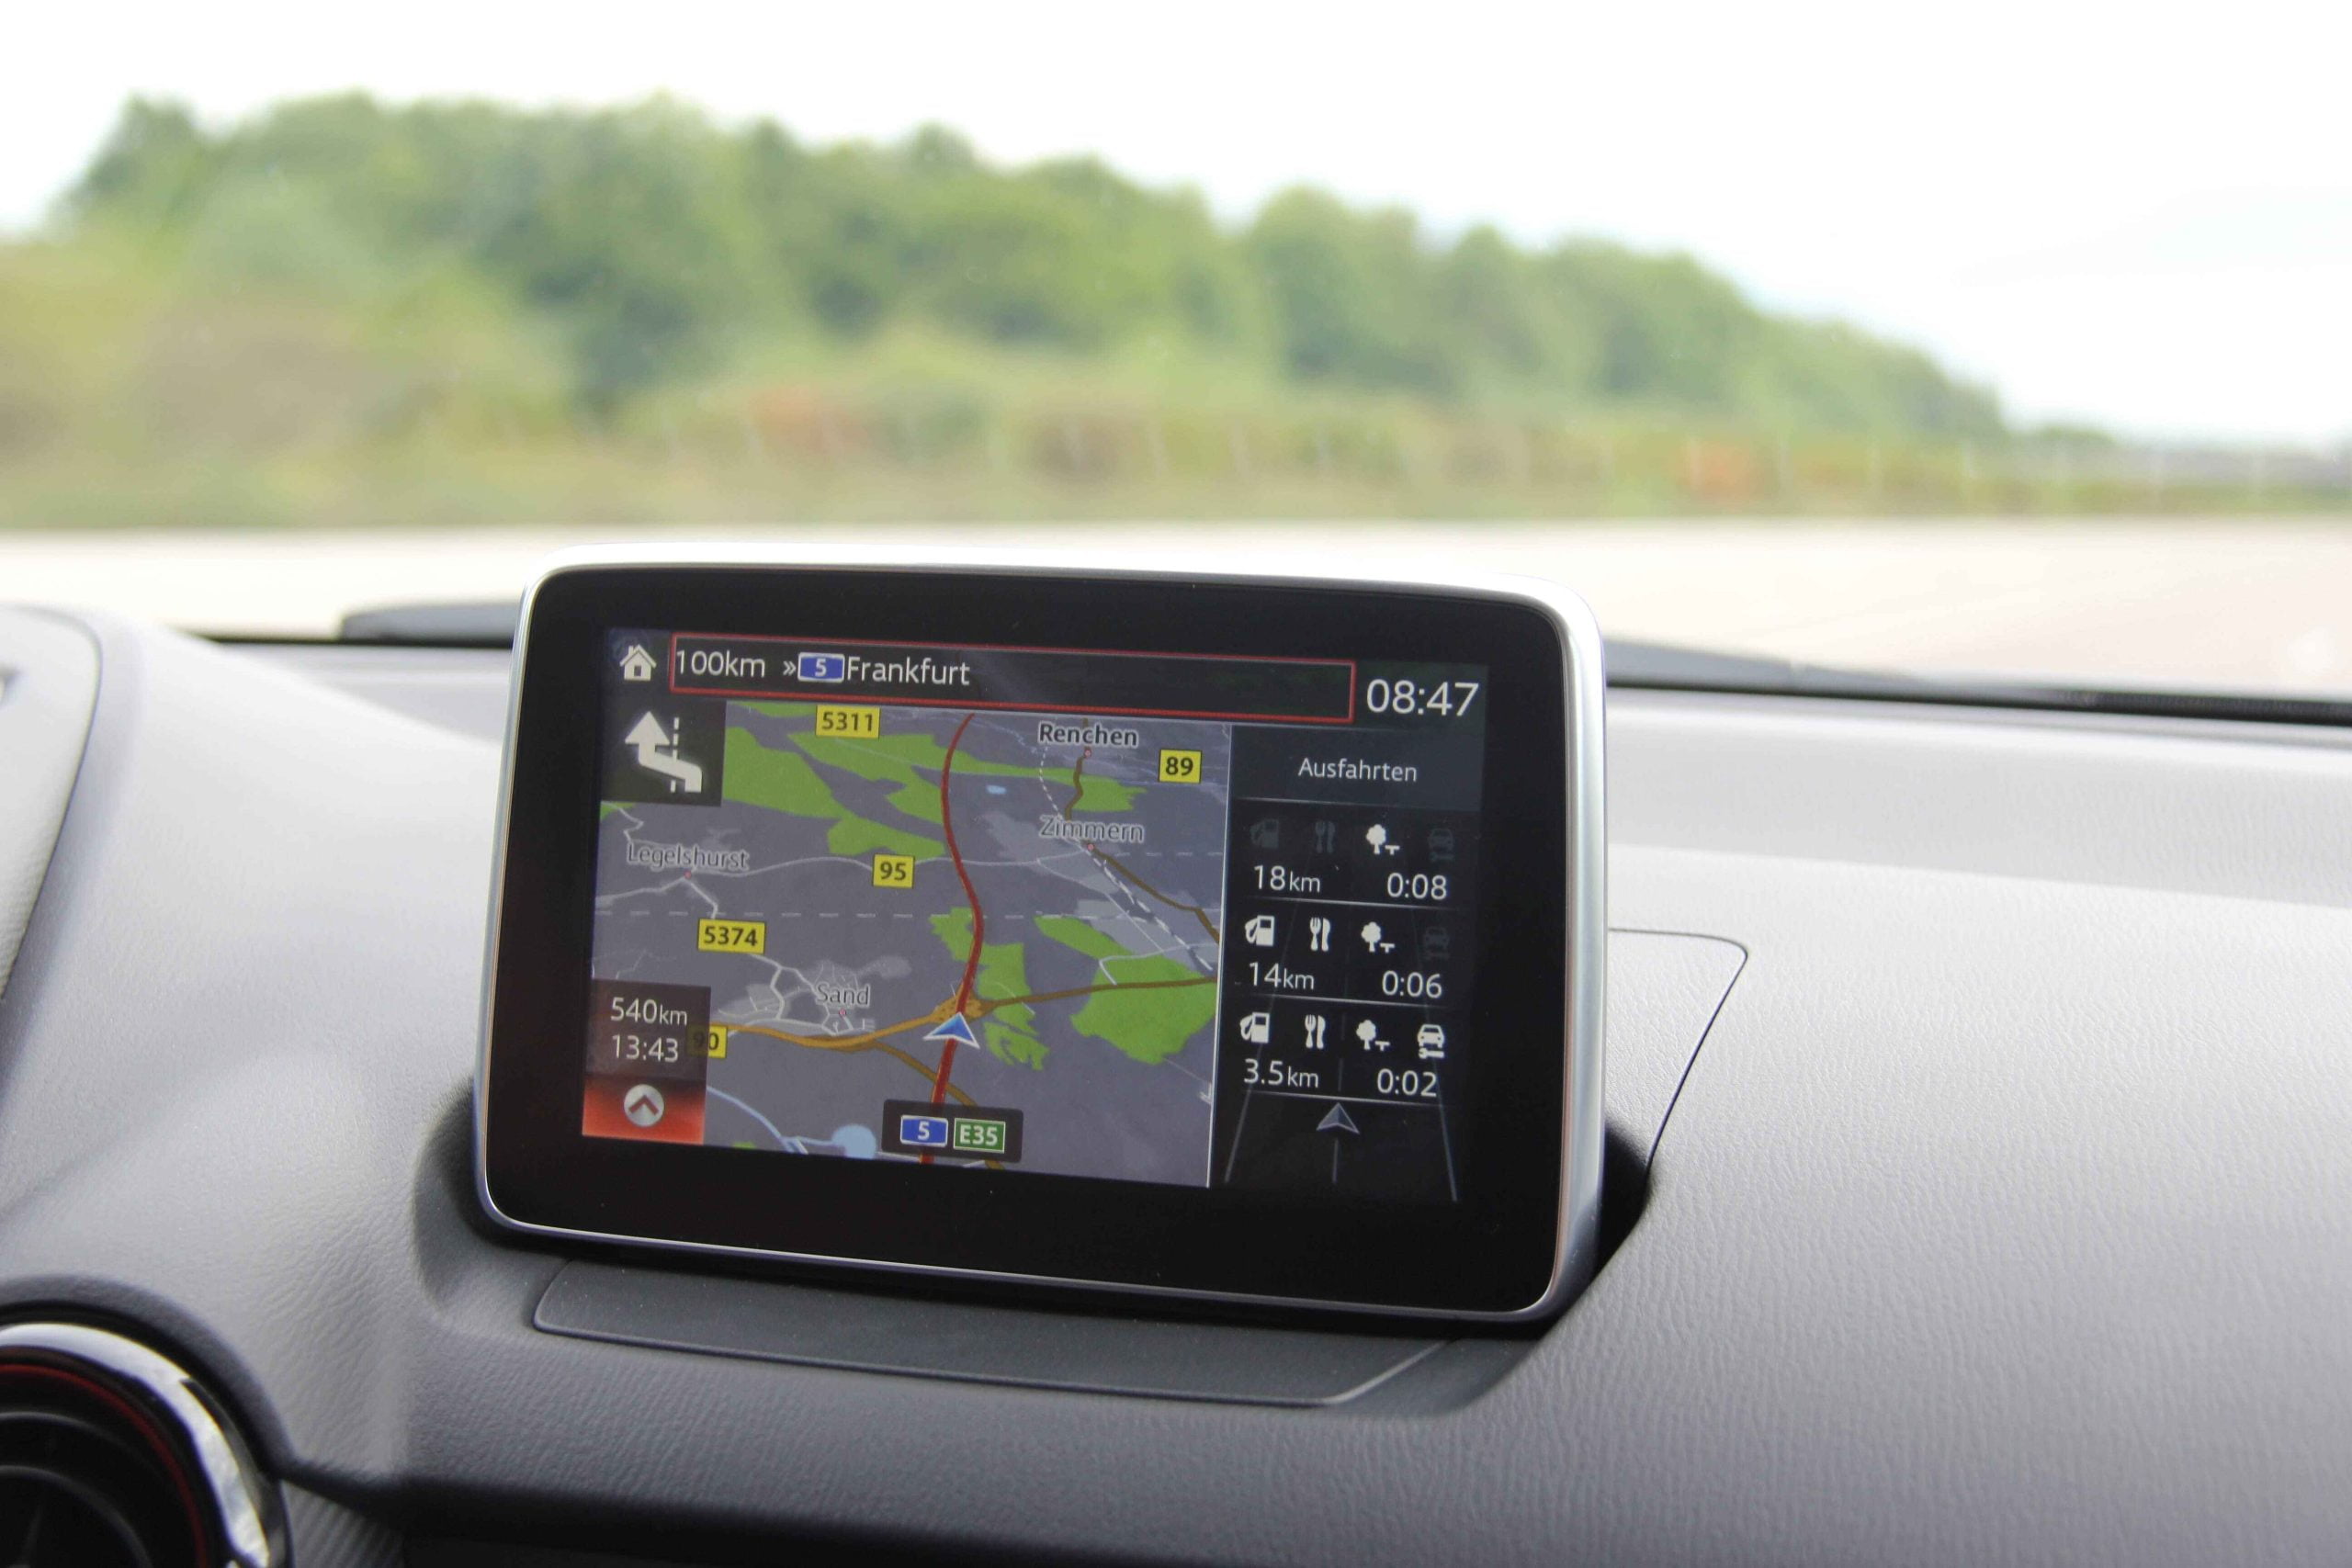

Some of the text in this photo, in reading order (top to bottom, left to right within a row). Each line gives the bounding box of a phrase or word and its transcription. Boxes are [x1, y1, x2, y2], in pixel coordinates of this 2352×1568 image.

[676, 649, 971, 686] 100km 5 Frankfurt
[1366, 678, 1479, 717] 08:47
[822, 711, 875, 732] 5311
[1040, 722, 1138, 747] Renchen
[1166, 756, 1193, 777] 89
[1298, 757, 1418, 783] Ausfahrten
[1041, 816, 1145, 844] Zimmern
[627, 842, 750, 872] Legelshurst
[879, 861, 907, 881] 95
[1253, 864, 1448, 900] 18km 0:08
[703, 926, 758, 947] 5374
[1250, 962, 1442, 998] 14km 0:06
[816, 982, 871, 1007] Sand
[610, 996, 688, 1027] 540km
[611, 1033, 679, 1063] 13:43
[1377, 1068, 1437, 1097] 0:02
[918, 1121, 931, 1140] 5
[959, 1123, 1000, 1147] E35
